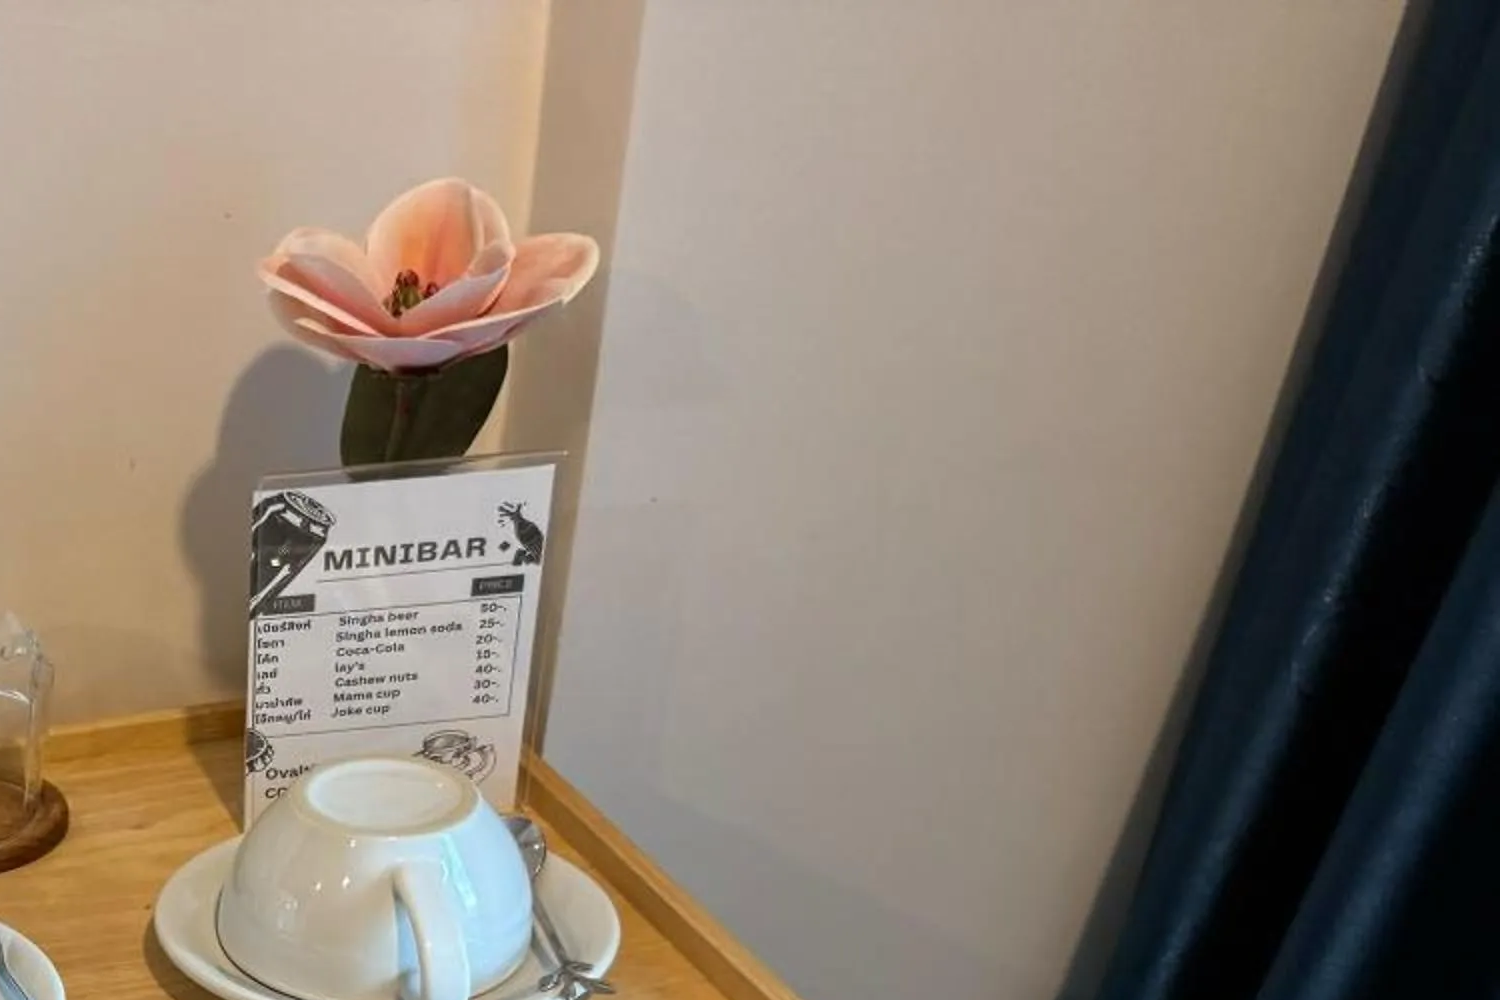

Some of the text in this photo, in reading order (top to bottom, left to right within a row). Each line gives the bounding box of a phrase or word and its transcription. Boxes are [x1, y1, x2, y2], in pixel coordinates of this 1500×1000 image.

[323, 537, 487, 572] MINIBAR
[338, 611, 420, 627] Singha beer
[335, 621, 463, 642] Singha lemon soda
[335, 642, 406, 657] Coca-Cola
[334, 672, 419, 688] Cashew nuts
[332, 688, 401, 703] Mama cup
[330, 704, 391, 718] Joke cup
